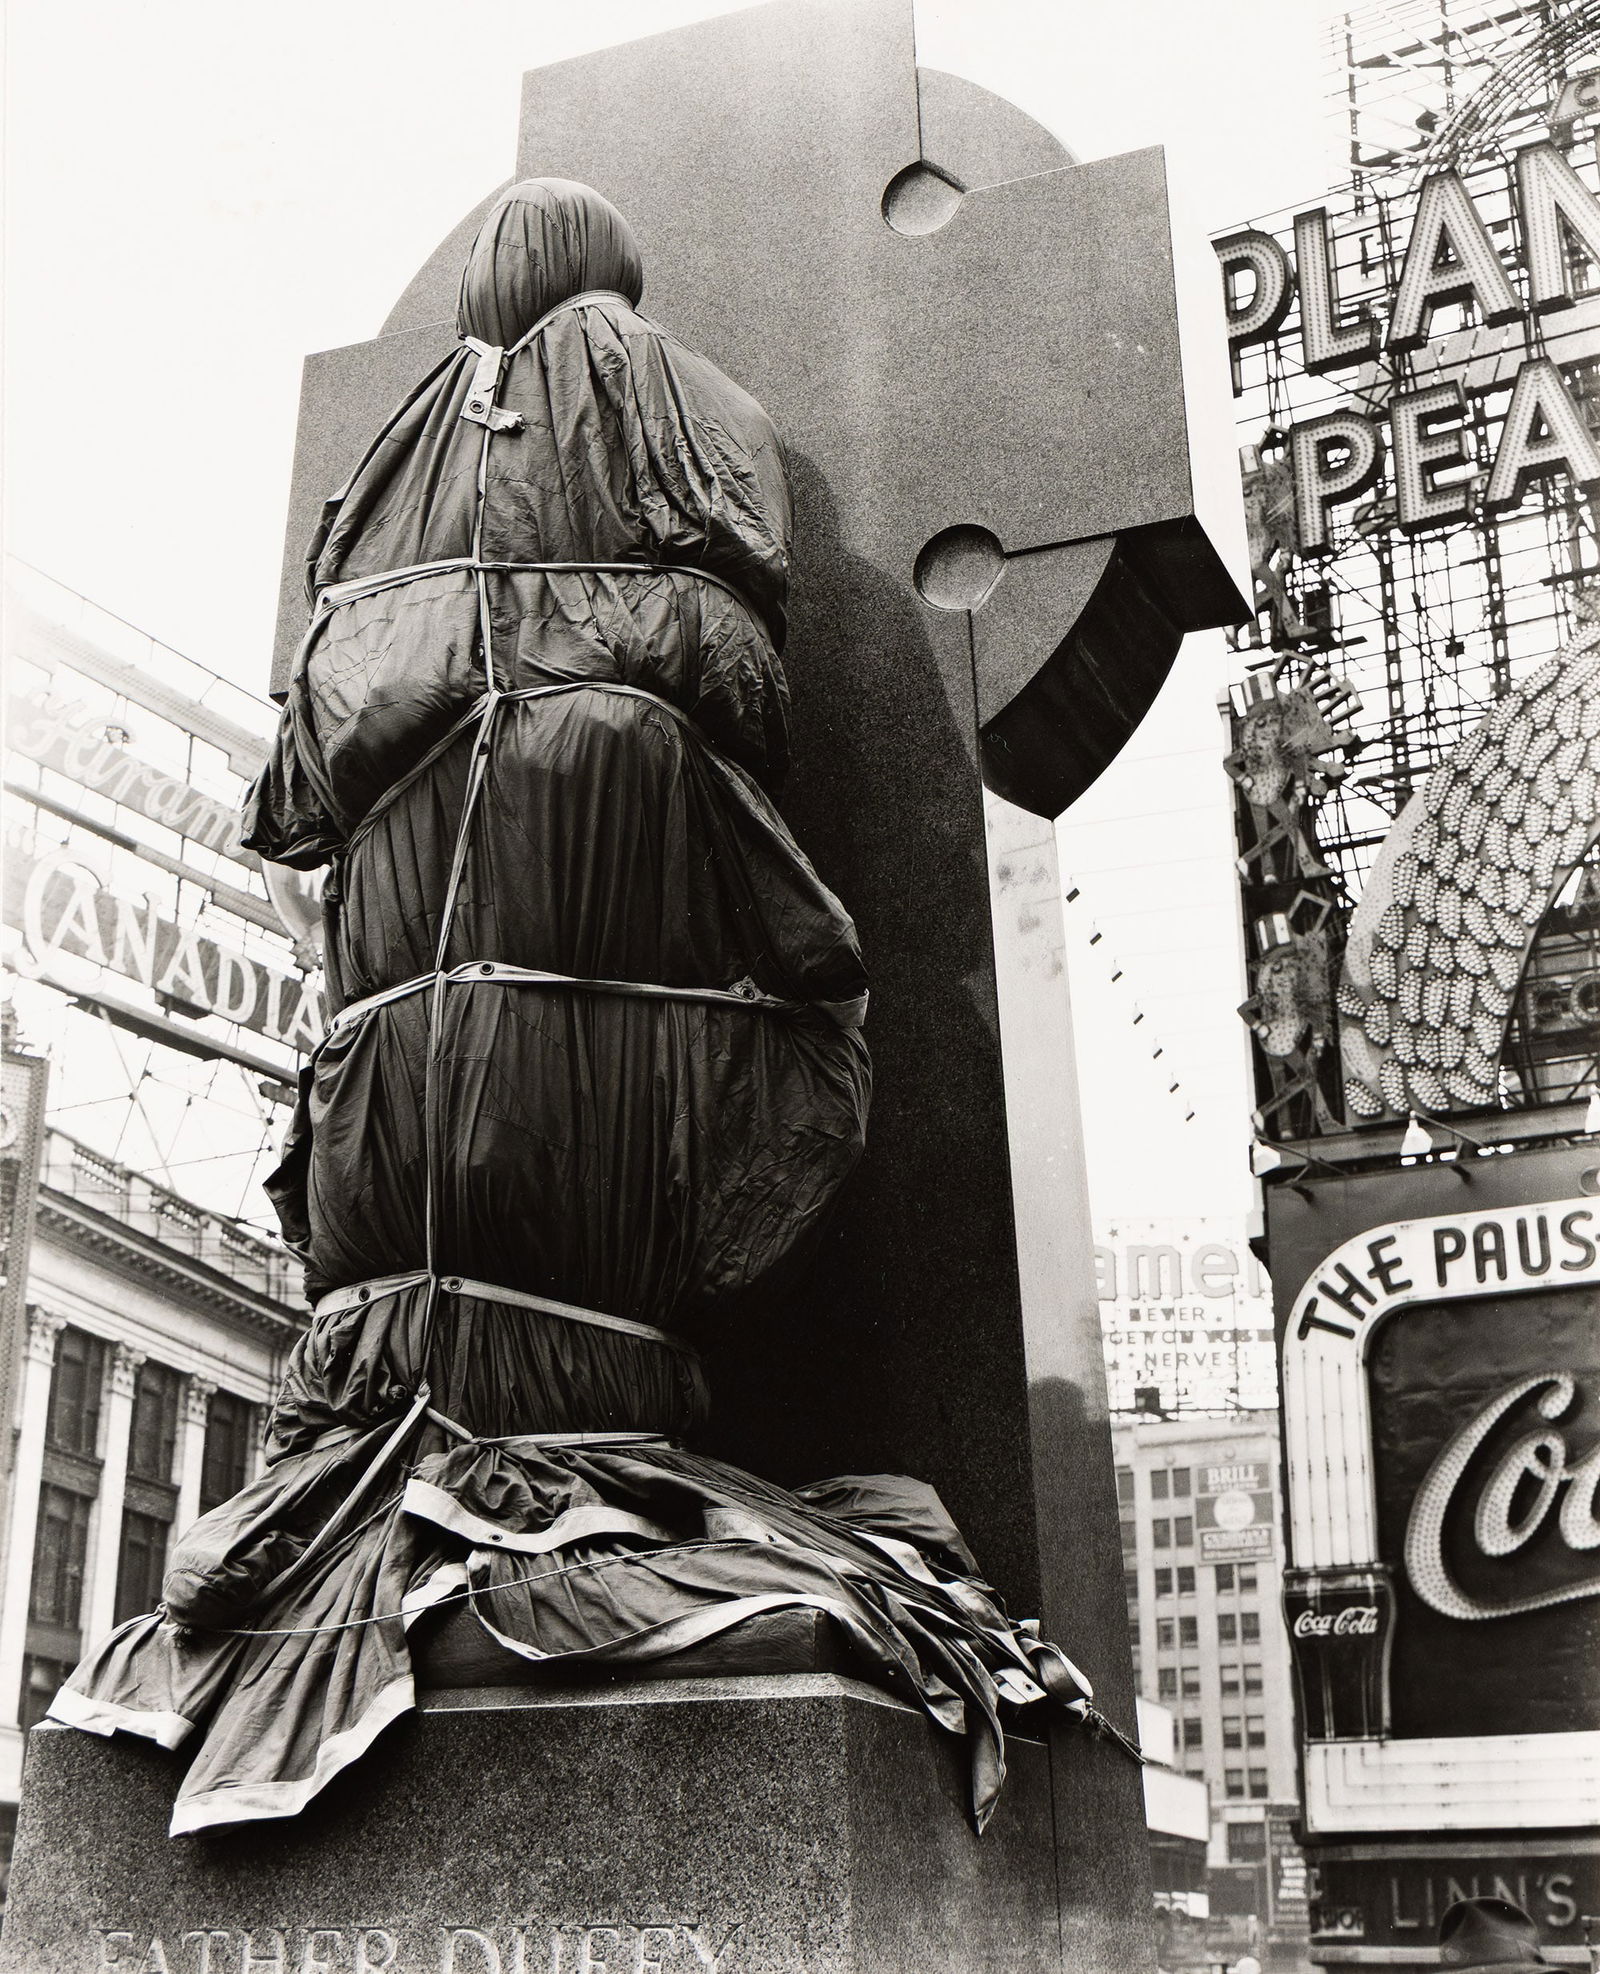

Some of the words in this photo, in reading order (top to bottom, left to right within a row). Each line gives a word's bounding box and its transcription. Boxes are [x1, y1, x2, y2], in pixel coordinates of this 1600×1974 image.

[1289, 355, 1600, 555] PEA
[1298, 1234, 1413, 1340] THE
[1433, 1210, 1600, 1287] PAUS
[1145, 1352, 1249, 1369] NERVES!
[1207, 1465, 1260, 1486] BRILL
